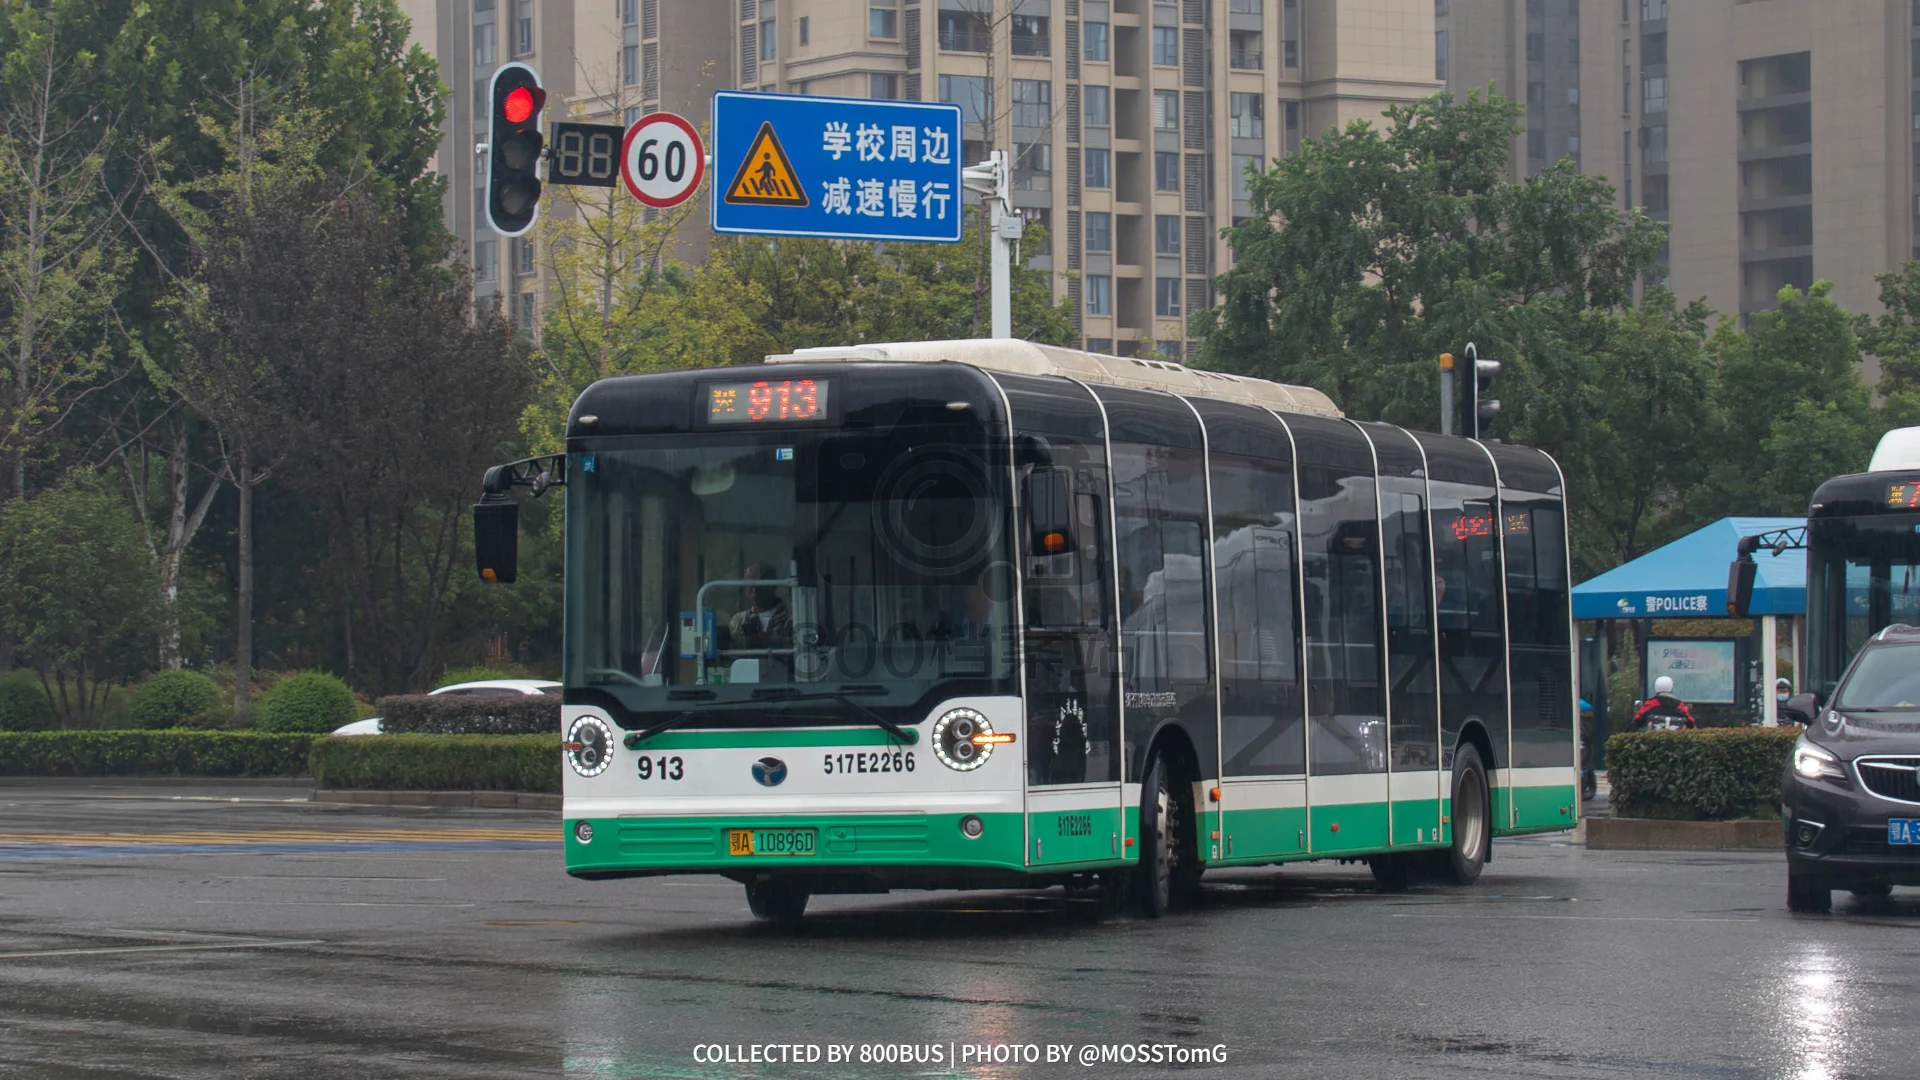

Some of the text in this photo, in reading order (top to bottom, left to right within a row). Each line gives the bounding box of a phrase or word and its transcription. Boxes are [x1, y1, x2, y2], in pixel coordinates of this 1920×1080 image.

[638, 139, 684, 182] 60
[822, 121, 951, 165] 学校周边
[821, 176, 951, 220] 减速慢行
[747, 379, 817, 421] 913
[1646, 596, 1707, 612] 警POLICE察
[637, 756, 684, 781] 913
[823, 752, 916, 775] 517E2266
